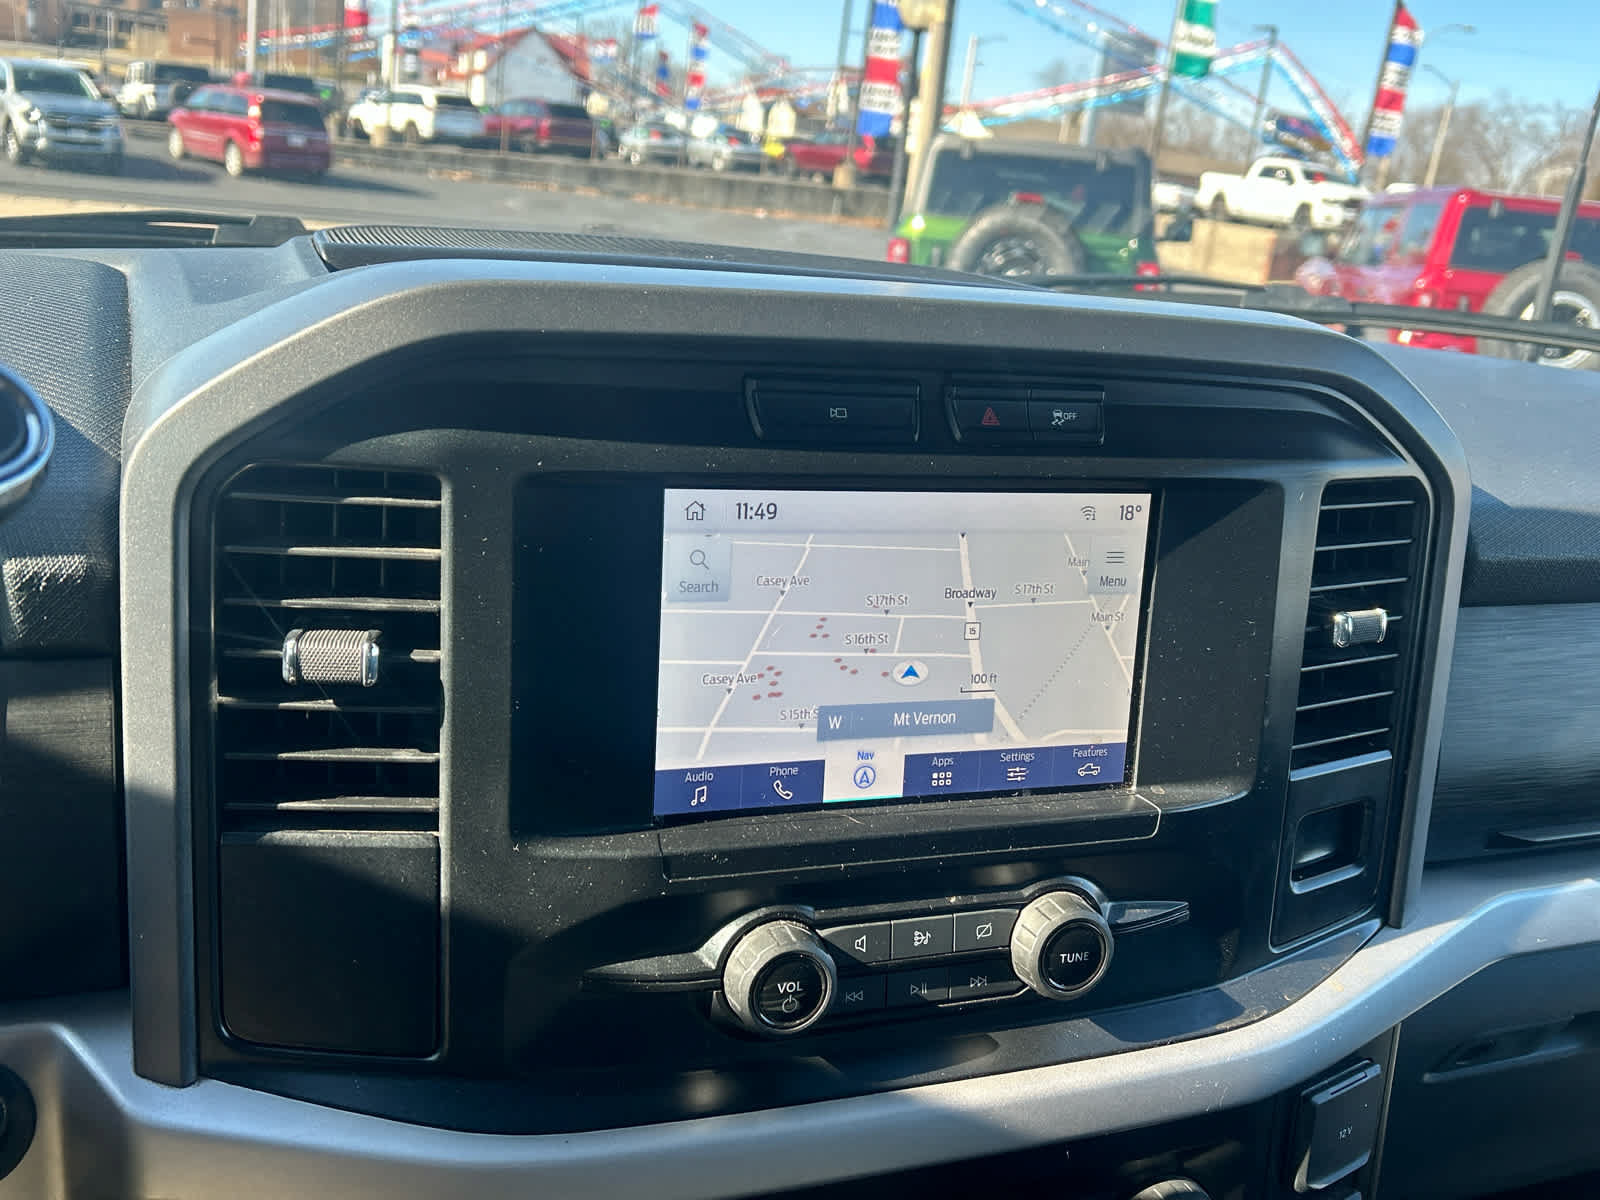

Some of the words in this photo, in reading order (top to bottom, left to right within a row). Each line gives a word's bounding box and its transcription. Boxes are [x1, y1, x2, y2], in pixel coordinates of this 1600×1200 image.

[1063, 412, 1080, 420] OFF
[735, 502, 778, 521] 11:49
[1119, 505, 1142, 521] 18°
[1067, 557, 1090, 567] Main
[679, 580, 719, 594] Search
[756, 576, 788, 587] Casey
[790, 575, 810, 586] Ave
[1099, 576, 1127, 587] Menu
[944, 587, 997, 601] Broadway
[1014, 584, 1021, 594] S
[1023, 584, 1042, 594] 17th
[1043, 584, 1054, 594] St
[865, 595, 874, 606] S
[875, 595, 896, 606] 17th
[897, 595, 908, 606] St
[1091, 612, 1113, 622] Main
[1113, 612, 1124, 622] St
[845, 634, 852, 645] S
[854, 633, 876, 645] 16th
[877, 633, 889, 644] St
[702, 674, 735, 686] Casey
[736, 673, 757, 684] Ave
[970, 673, 988, 684] 100
[989, 673, 998, 684] ft
[780, 710, 787, 721] S
[789, 708, 811, 720] 15th
[893, 712, 910, 726] Mt
[913, 711, 956, 726] Vernon
[828, 715, 842, 729] W
[856, 751, 875, 761] Nav
[1000, 752, 1035, 764] Settings
[1072, 748, 1108, 758] Features
[931, 756, 954, 768] Apps
[684, 771, 714, 783] Audio
[769, 767, 799, 778] Phone
[1059, 951, 1090, 964] TUNE
[777, 981, 804, 994] VOL
